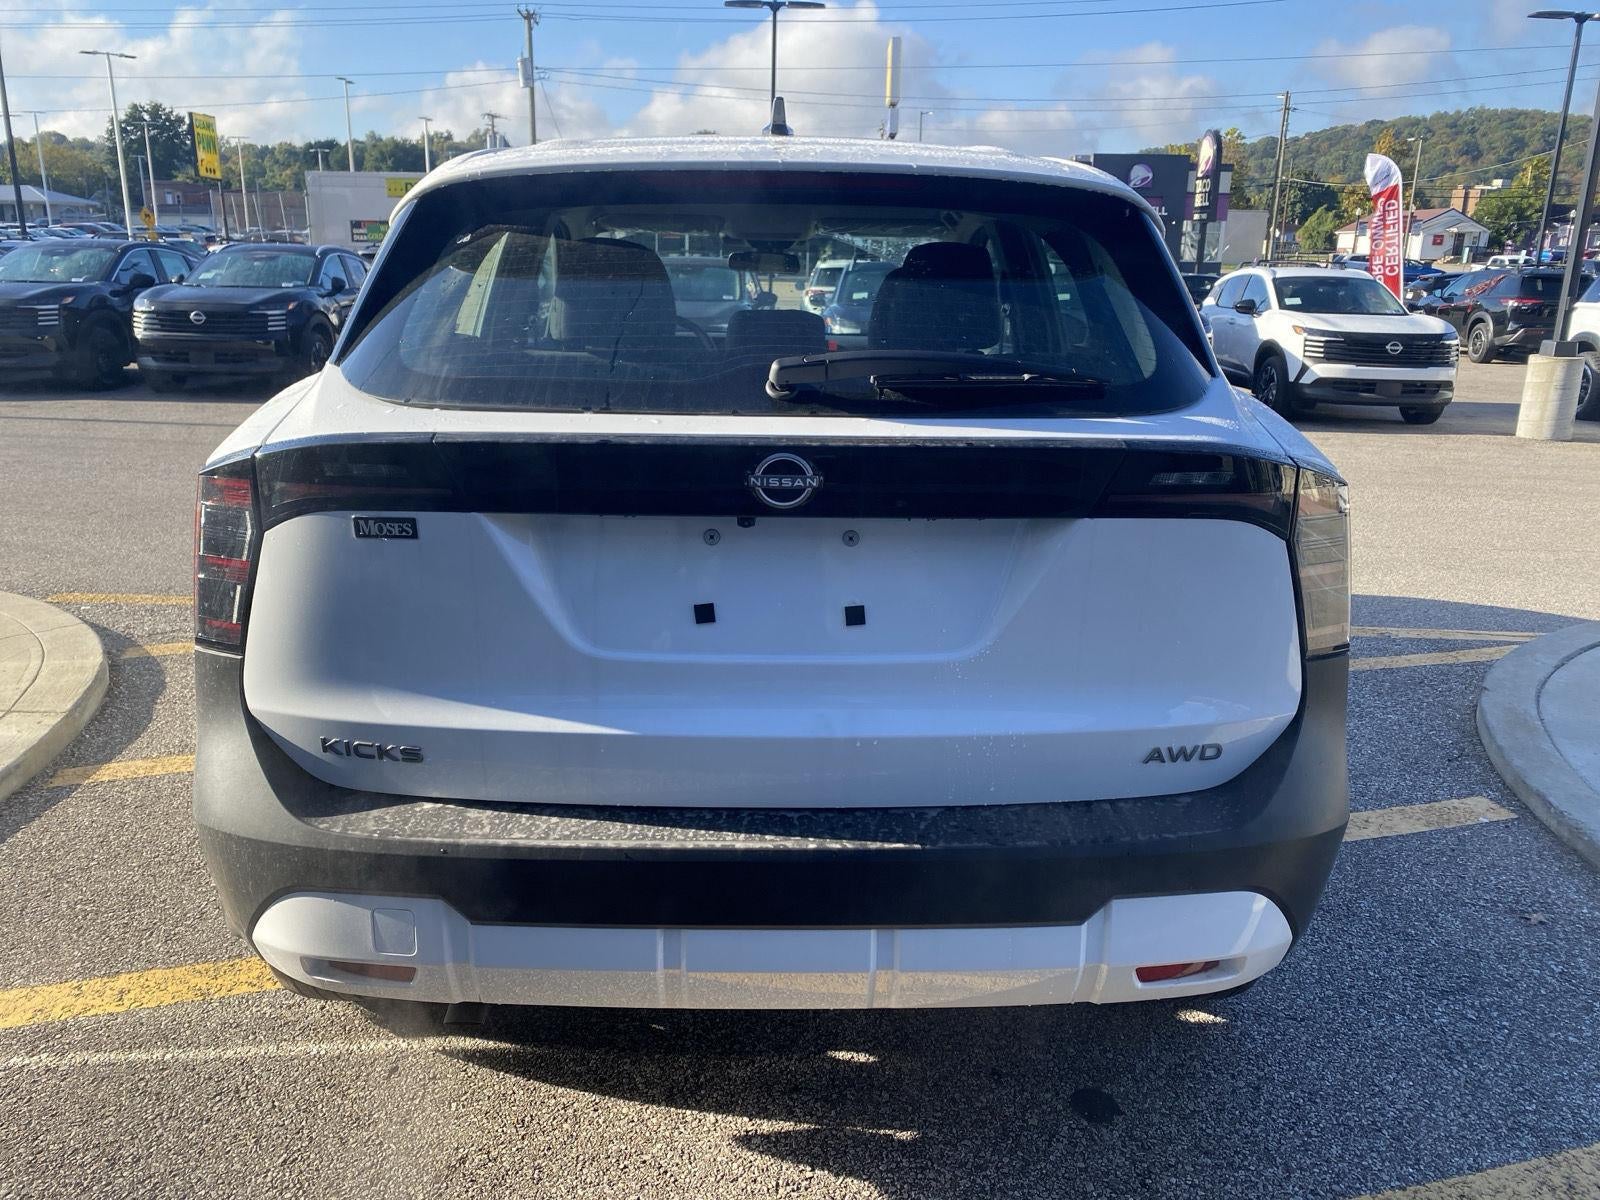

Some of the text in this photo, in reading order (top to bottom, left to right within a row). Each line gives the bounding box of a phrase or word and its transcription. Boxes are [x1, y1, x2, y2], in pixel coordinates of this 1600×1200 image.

[1195, 179, 1211, 193] TACO
[1194, 192, 1209, 207] BELL
[750, 477, 817, 487] NISSAN
[319, 736, 424, 763] KICKS
[1142, 743, 1223, 764] AWD
